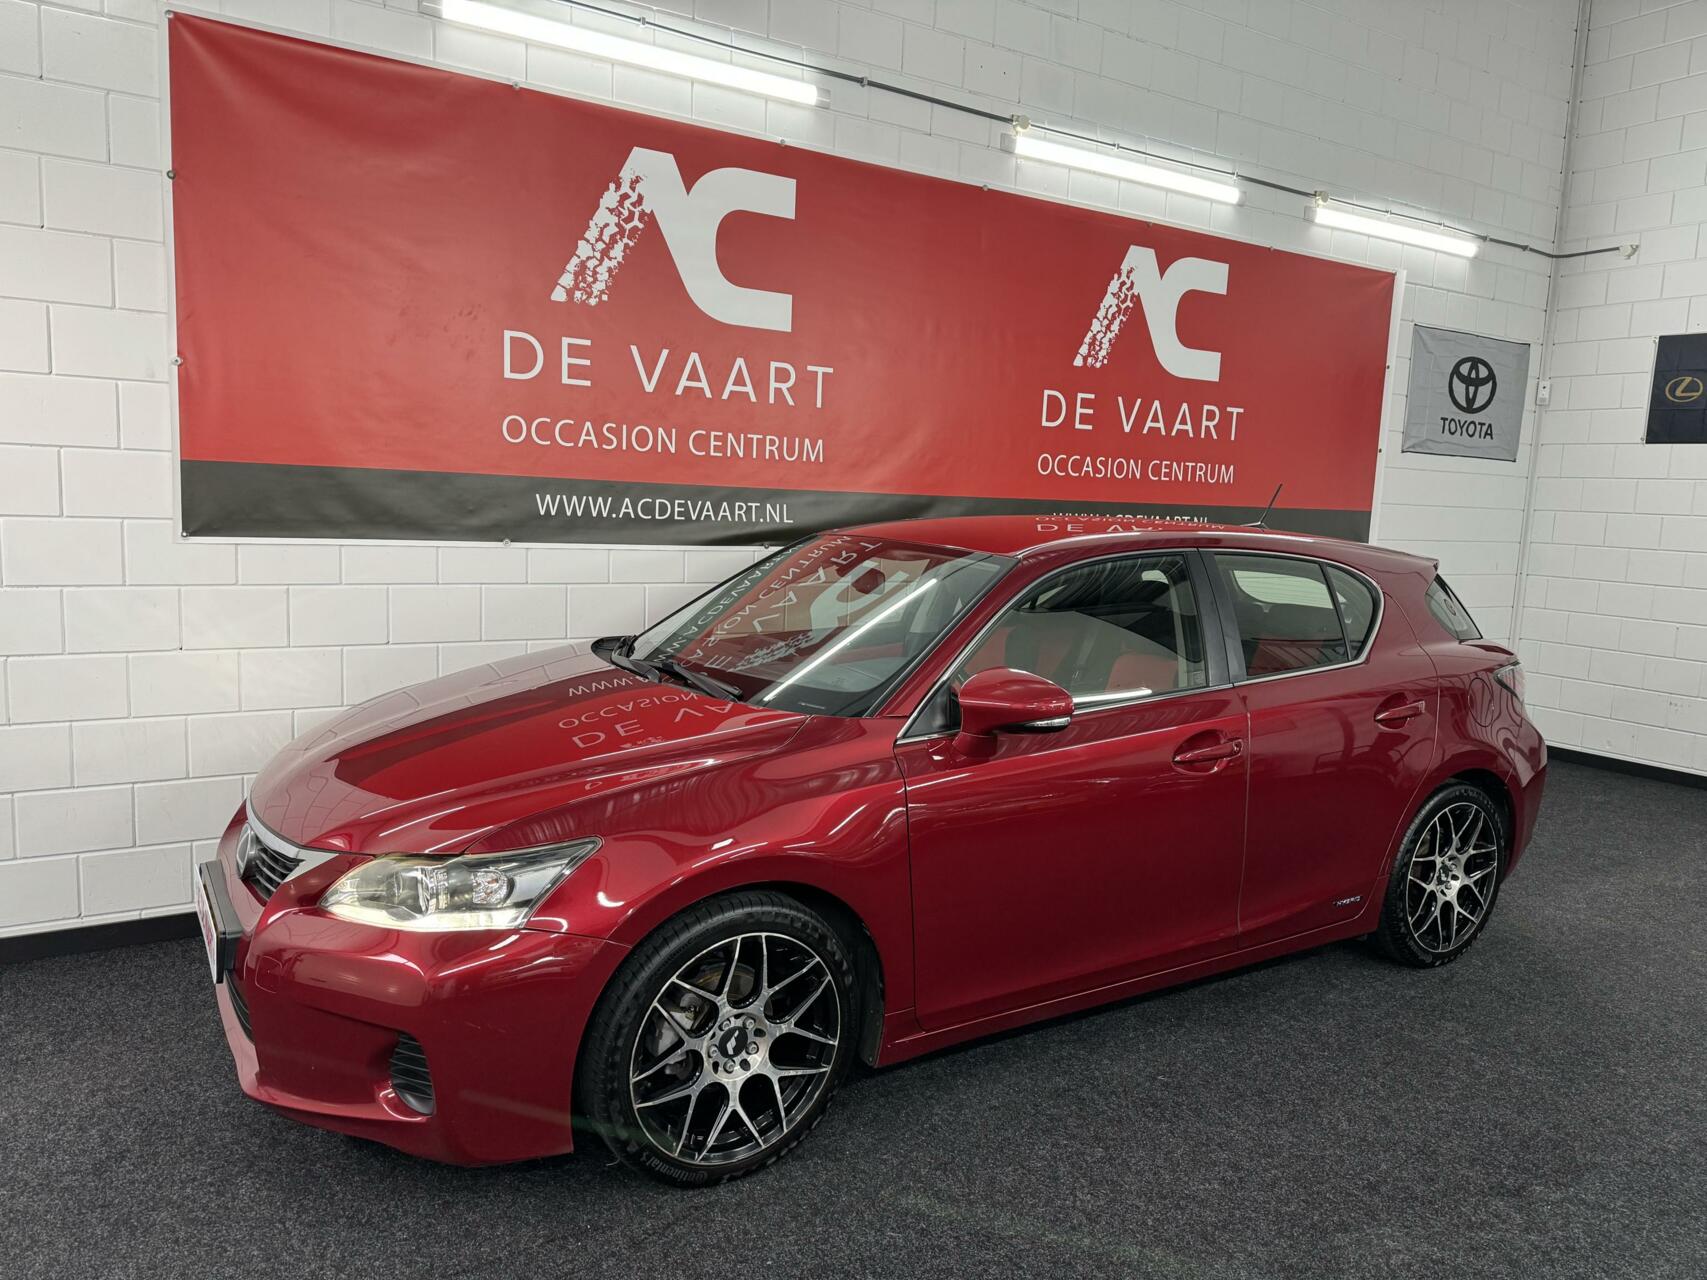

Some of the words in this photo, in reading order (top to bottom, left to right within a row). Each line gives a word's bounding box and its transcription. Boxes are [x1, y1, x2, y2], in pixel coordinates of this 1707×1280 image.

[550, 146, 797, 332] AC
[1073, 245, 1230, 382] AC
[503, 330, 592, 387] DE
[630, 344, 834, 409] VAART
[502, 415, 676, 454] OCCASION
[688, 430, 823, 463] CENTRUM
[1041, 389, 1096, 430] DE
[1117, 396, 1245, 441] VAART
[1440, 416, 1494, 440] TOYOTA
[1037, 453, 1142, 480] OCCASION
[1148, 460, 1235, 484] CENTRUM
[535, 493, 794, 524] WWW.ACDEVAART.NL
